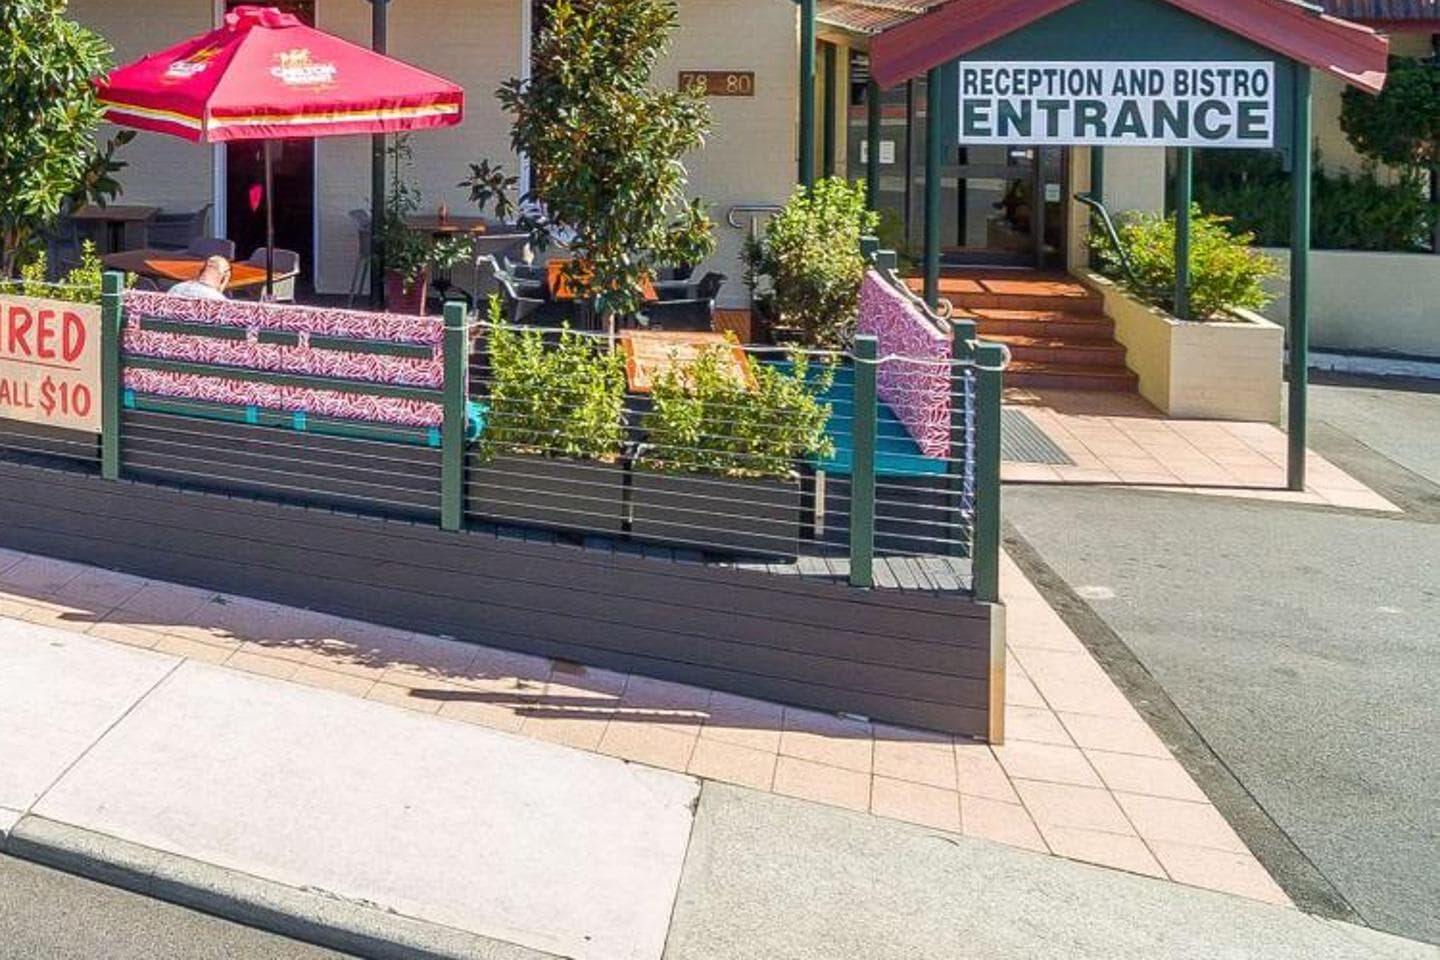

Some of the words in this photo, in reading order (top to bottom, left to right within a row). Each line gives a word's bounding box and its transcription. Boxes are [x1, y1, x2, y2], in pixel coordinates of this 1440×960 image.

[963, 68, 1103, 96] RECEPTION
[1111, 69, 1164, 96] AND
[1173, 69, 1269, 96] BISTRO
[963, 98, 1269, 139] ENTRANCE
[39, 375, 92, 417] $10
